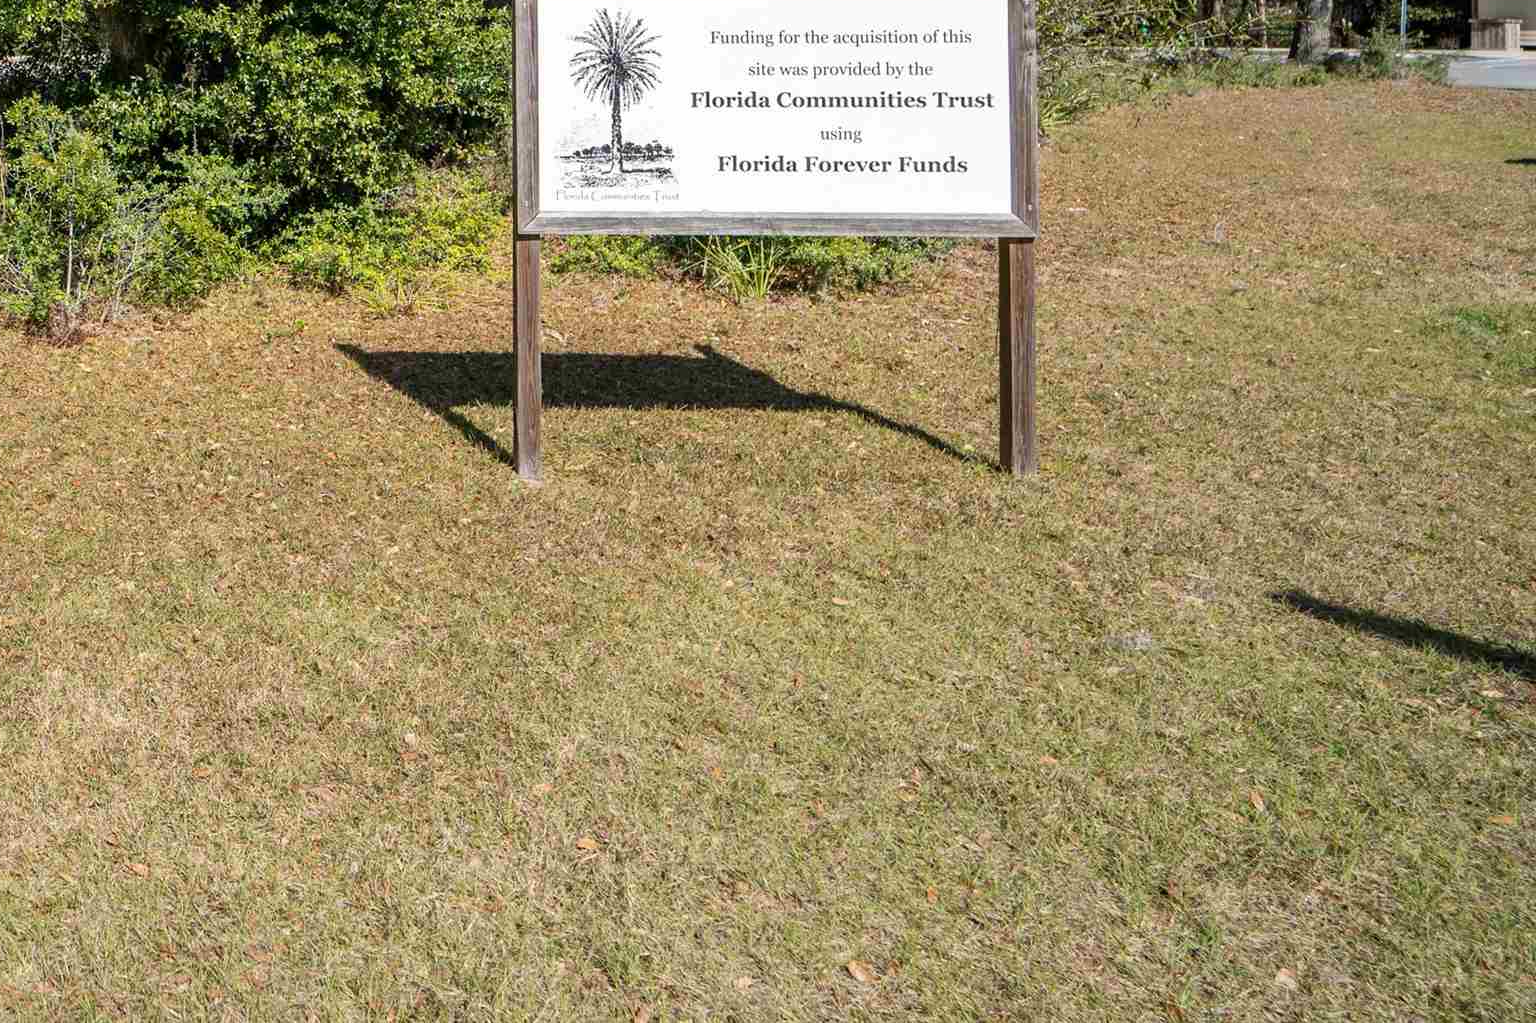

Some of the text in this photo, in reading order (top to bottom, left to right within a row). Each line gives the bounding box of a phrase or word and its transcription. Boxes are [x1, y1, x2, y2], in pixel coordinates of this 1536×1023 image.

[710, 29, 972, 47] Funding for the acquisition of this
[748, 61, 934, 80] site was provided by the
[690, 91, 995, 109] Florida Communities Trust
[820, 126, 863, 144] using
[717, 155, 968, 173] Florida Forever Funds
